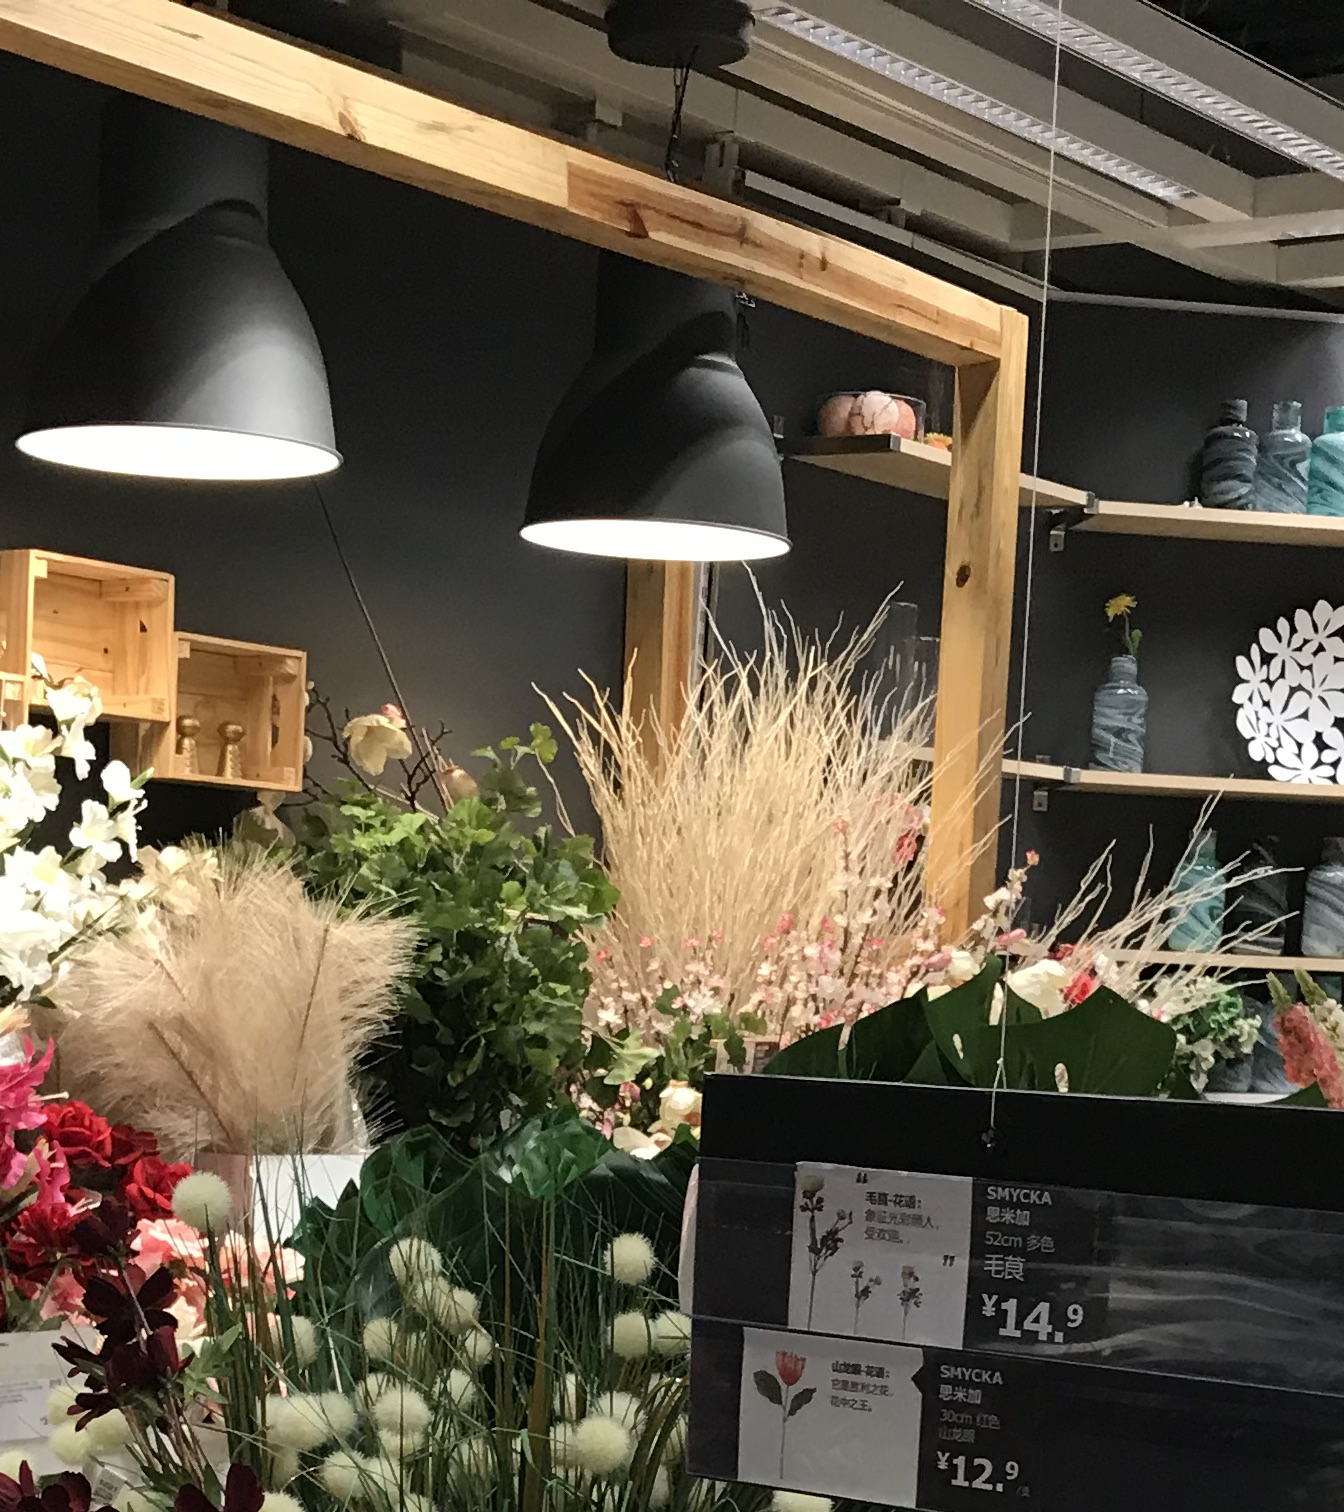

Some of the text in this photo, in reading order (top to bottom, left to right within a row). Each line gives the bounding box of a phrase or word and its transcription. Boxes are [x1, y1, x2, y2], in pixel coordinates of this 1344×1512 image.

[987, 1186, 1052, 1206] SMYCKA
[985, 1206, 1030, 1227] 思米加
[984, 1231, 1055, 1253] 52cm 多色
[983, 1254, 1026, 1282] 毛茛
[981, 1293, 1084, 1343] ¥14.9
[940, 1365, 1004, 1385] SMYCKA
[938, 1384, 982, 1405] 思米加
[939, 1408, 973, 1425] 30cm
[936, 1450, 1020, 1493] ¥12.9
